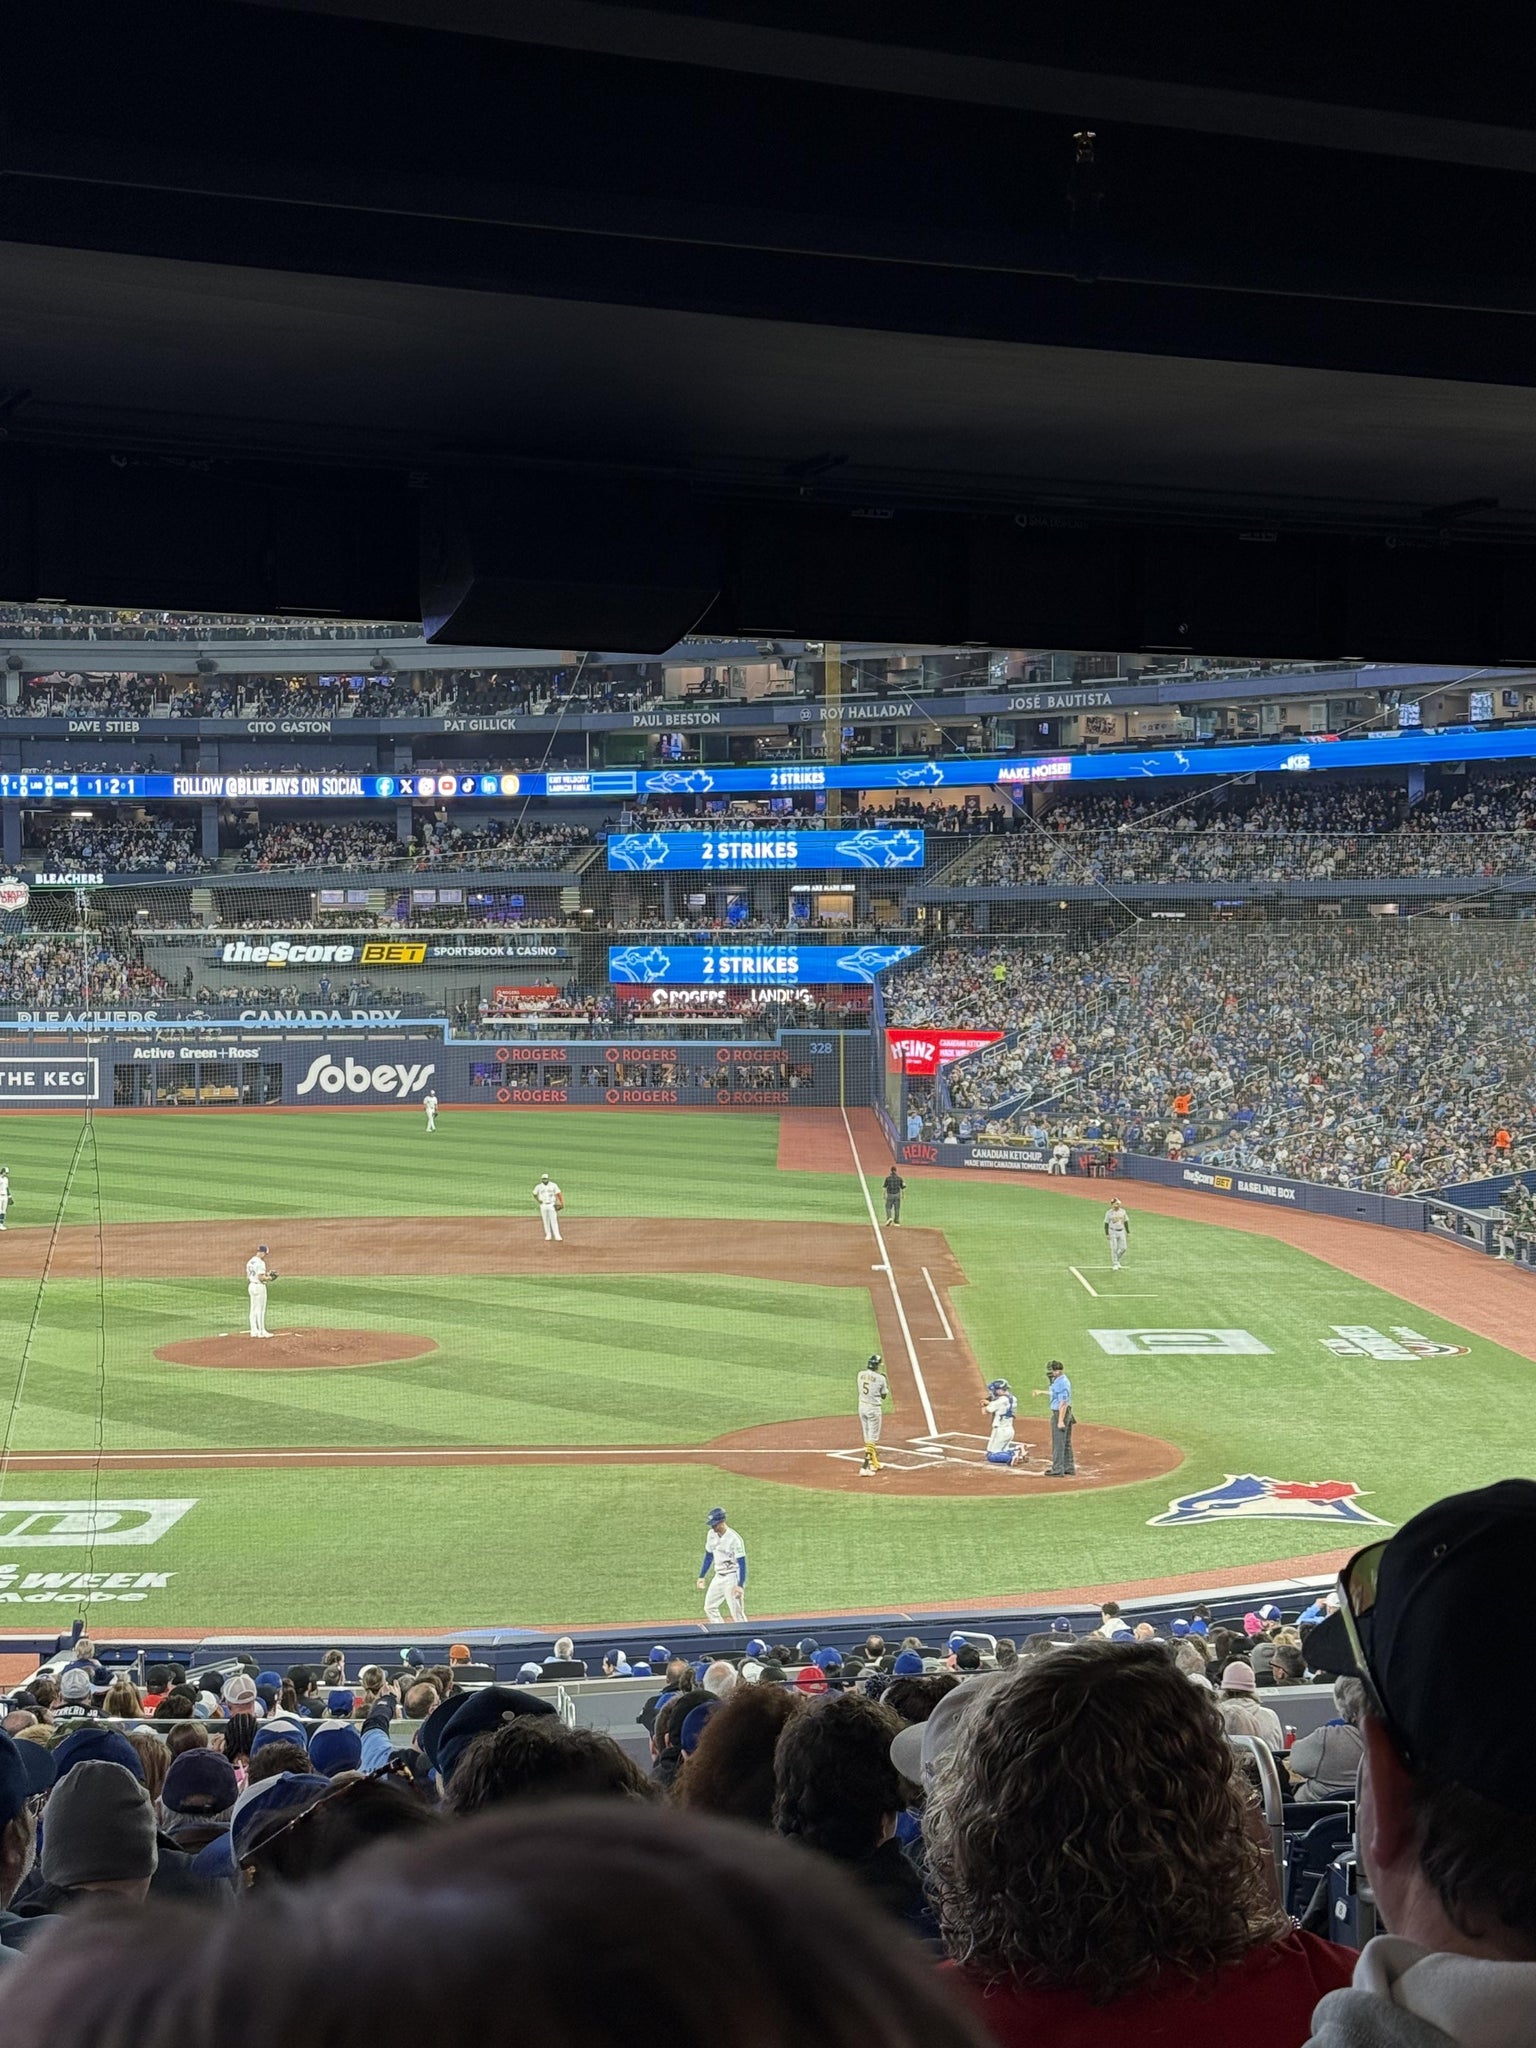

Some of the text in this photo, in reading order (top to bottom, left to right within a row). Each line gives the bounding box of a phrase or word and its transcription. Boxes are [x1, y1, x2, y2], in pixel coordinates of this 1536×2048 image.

[1008, 693, 1112, 710] JOSÉ BAUTISTA
[820, 708, 845, 720] ROY
[848, 704, 913, 719] HALLADAY
[69, 721, 140, 732] DAVE STIEB
[444, 719, 516, 731] PAT GILLICK
[633, 713, 720, 727] PAUL BEESTON
[247, 722, 331, 733] CITO GASTON
[770, 772, 825, 785] 2 STRIKES
[998, 768, 1030, 779] MAKE
[95, 779, 101, 794] 1
[110, 779, 119, 794] 2
[128, 779, 134, 794] 1
[174, 777, 365, 797] FOLLOW @BLUEJAYS ON SOCIAL
[702, 841, 798, 859] 2 STRIKES
[35, 874, 104, 884] BLEACHERS
[223, 942, 422, 962] theScore BET
[434, 947, 556, 956] SPORTSBOOK & CASINO
[703, 957, 799, 973] 2 STRIKES
[17, 1011, 158, 1032] BLEACHERS
[239, 1010, 346, 1028] CANADA
[133, 1047, 175, 1059] Active
[512, 1048, 567, 1061] ROGERS
[810, 1042, 833, 1054] 328
[890, 1040, 936, 1061] HEINZ
[623, 1049, 677, 1061] ROGERS
[734, 1050, 788, 1062] ROGERS
[44, 1072, 84, 1086] KEG
[297, 1054, 435, 1097] Sobeys
[514, 1089, 567, 1102] ROGERS
[623, 1090, 677, 1102] ROGERS
[734, 1091, 788, 1103] ROGERS
[902, 1144, 938, 1162] HEINZ
[972, 1148, 1043, 1161] CANADIAN KETCHUP.
[964, 1159, 979, 1167] MADE
[980, 1160, 993, 1168] WITH
[994, 1161, 1020, 1169] CANADIAN
[1078, 1154, 1118, 1171] HEZ
[1215, 1177, 1229, 1188] BET
[1238, 1181, 1296, 1200] BASELINE BOX
[863, 1382, 869, 1395] 5
[19, 1573, 178, 1588] WEEK
[0, 1592, 148, 1602] Adobe
